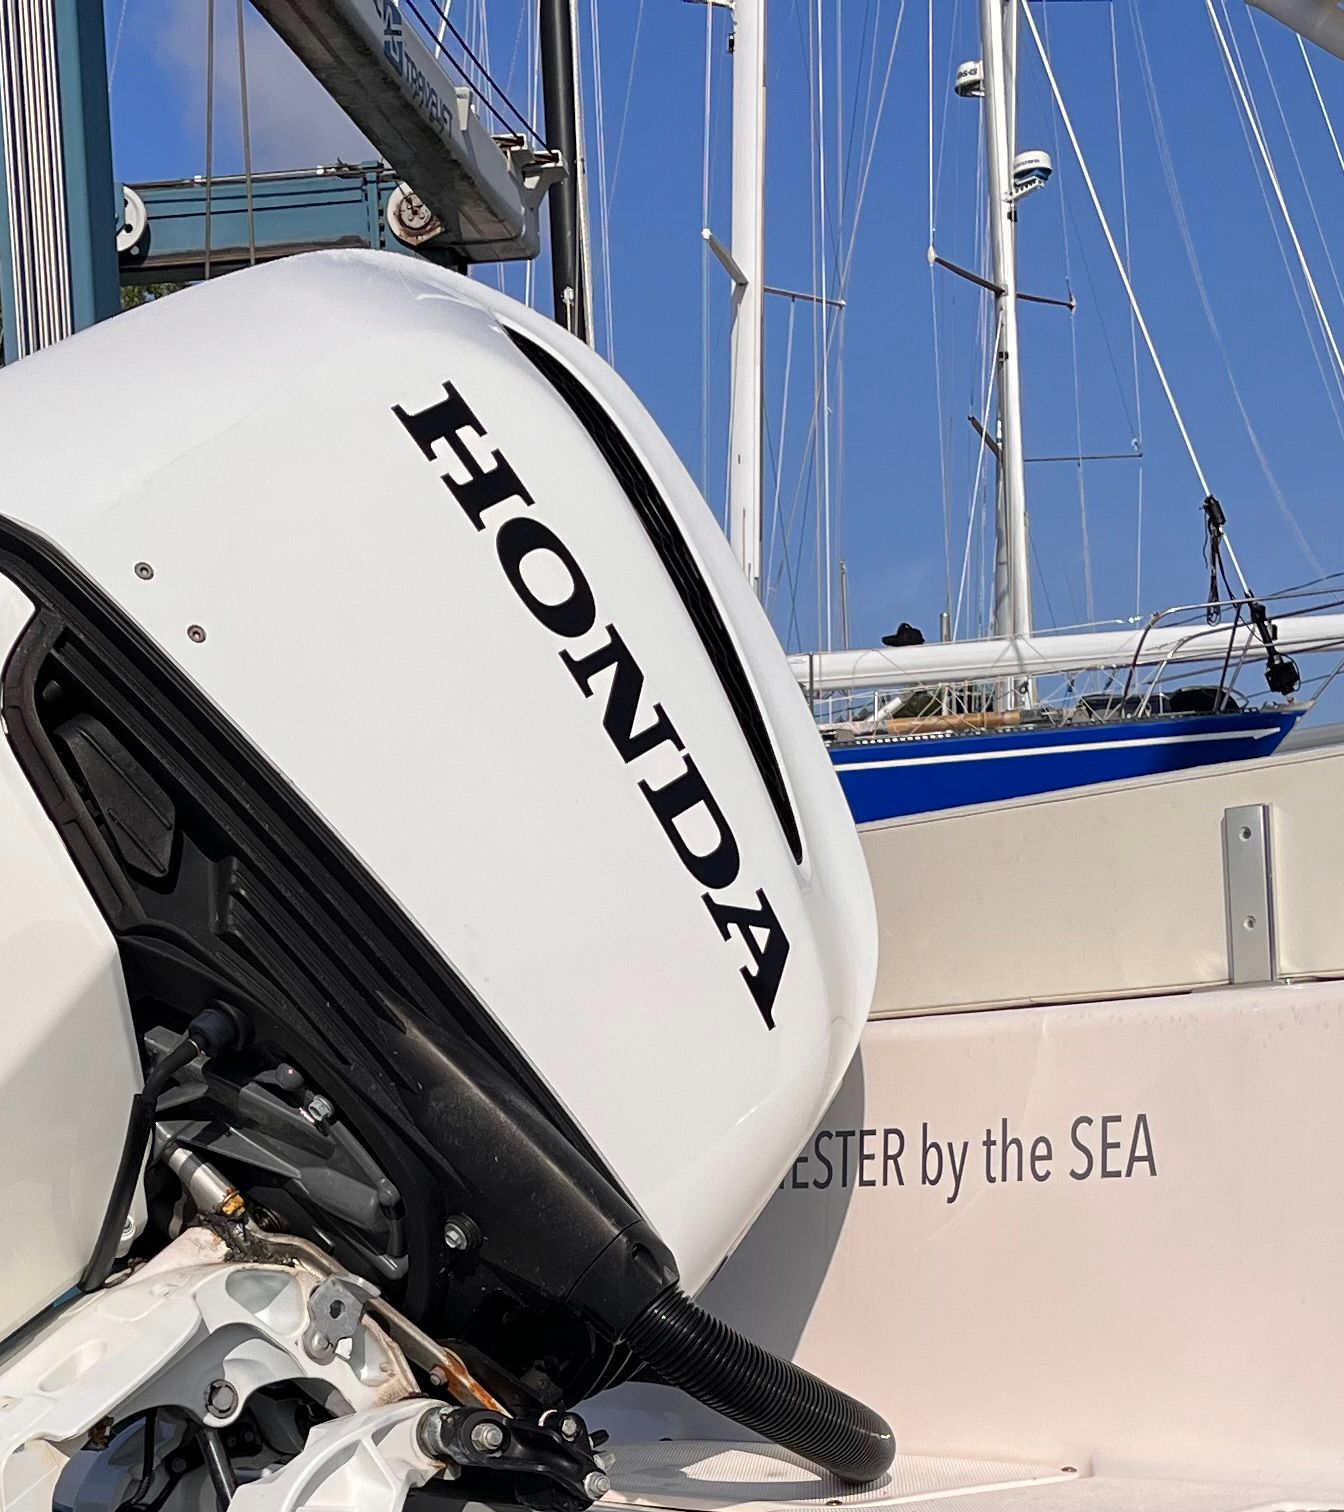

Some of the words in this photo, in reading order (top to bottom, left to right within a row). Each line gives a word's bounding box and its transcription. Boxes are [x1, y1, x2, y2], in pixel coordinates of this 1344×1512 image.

[391, 380, 791, 1030] HONDA
[778, 1128, 905, 1189] ESTER
[921, 1122, 969, 1203] by
[982, 1117, 1053, 1183] the
[1069, 1113, 1157, 1180] SEA
